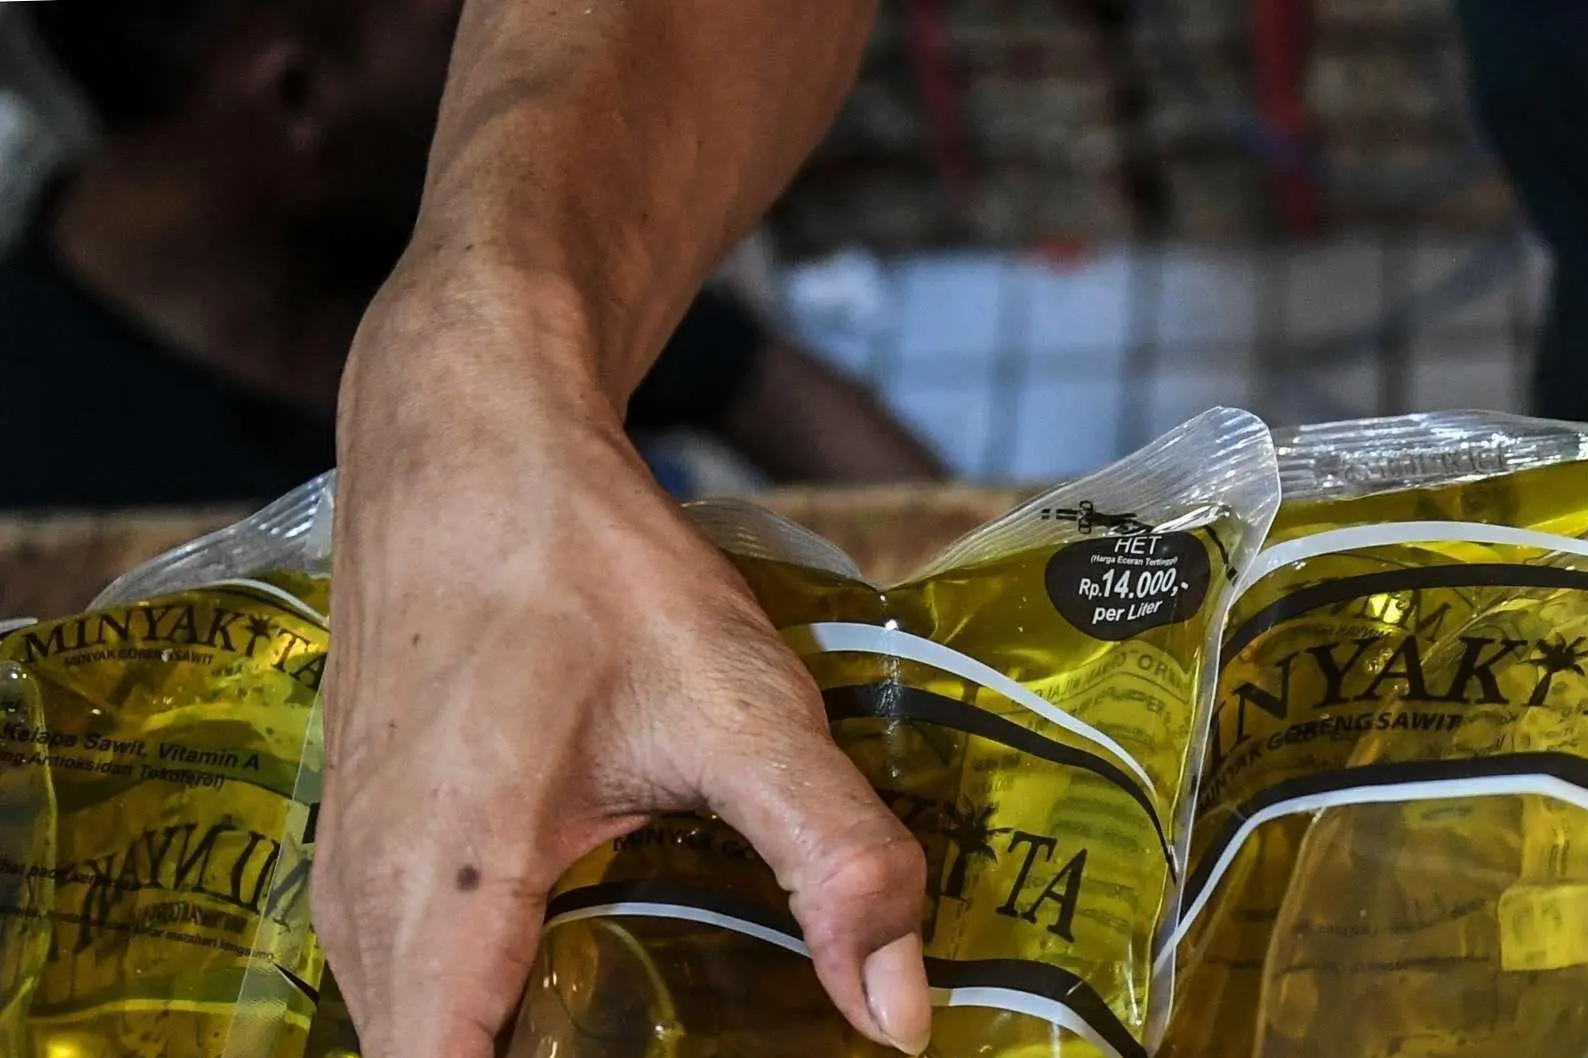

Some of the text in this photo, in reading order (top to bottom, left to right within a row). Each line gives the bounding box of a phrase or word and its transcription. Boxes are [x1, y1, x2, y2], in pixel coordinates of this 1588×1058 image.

[1114, 536, 1162, 555] HET
[1092, 600, 1163, 624] per Liter
[158, 743, 239, 768] Vitamin
[242, 754, 261, 772] A
